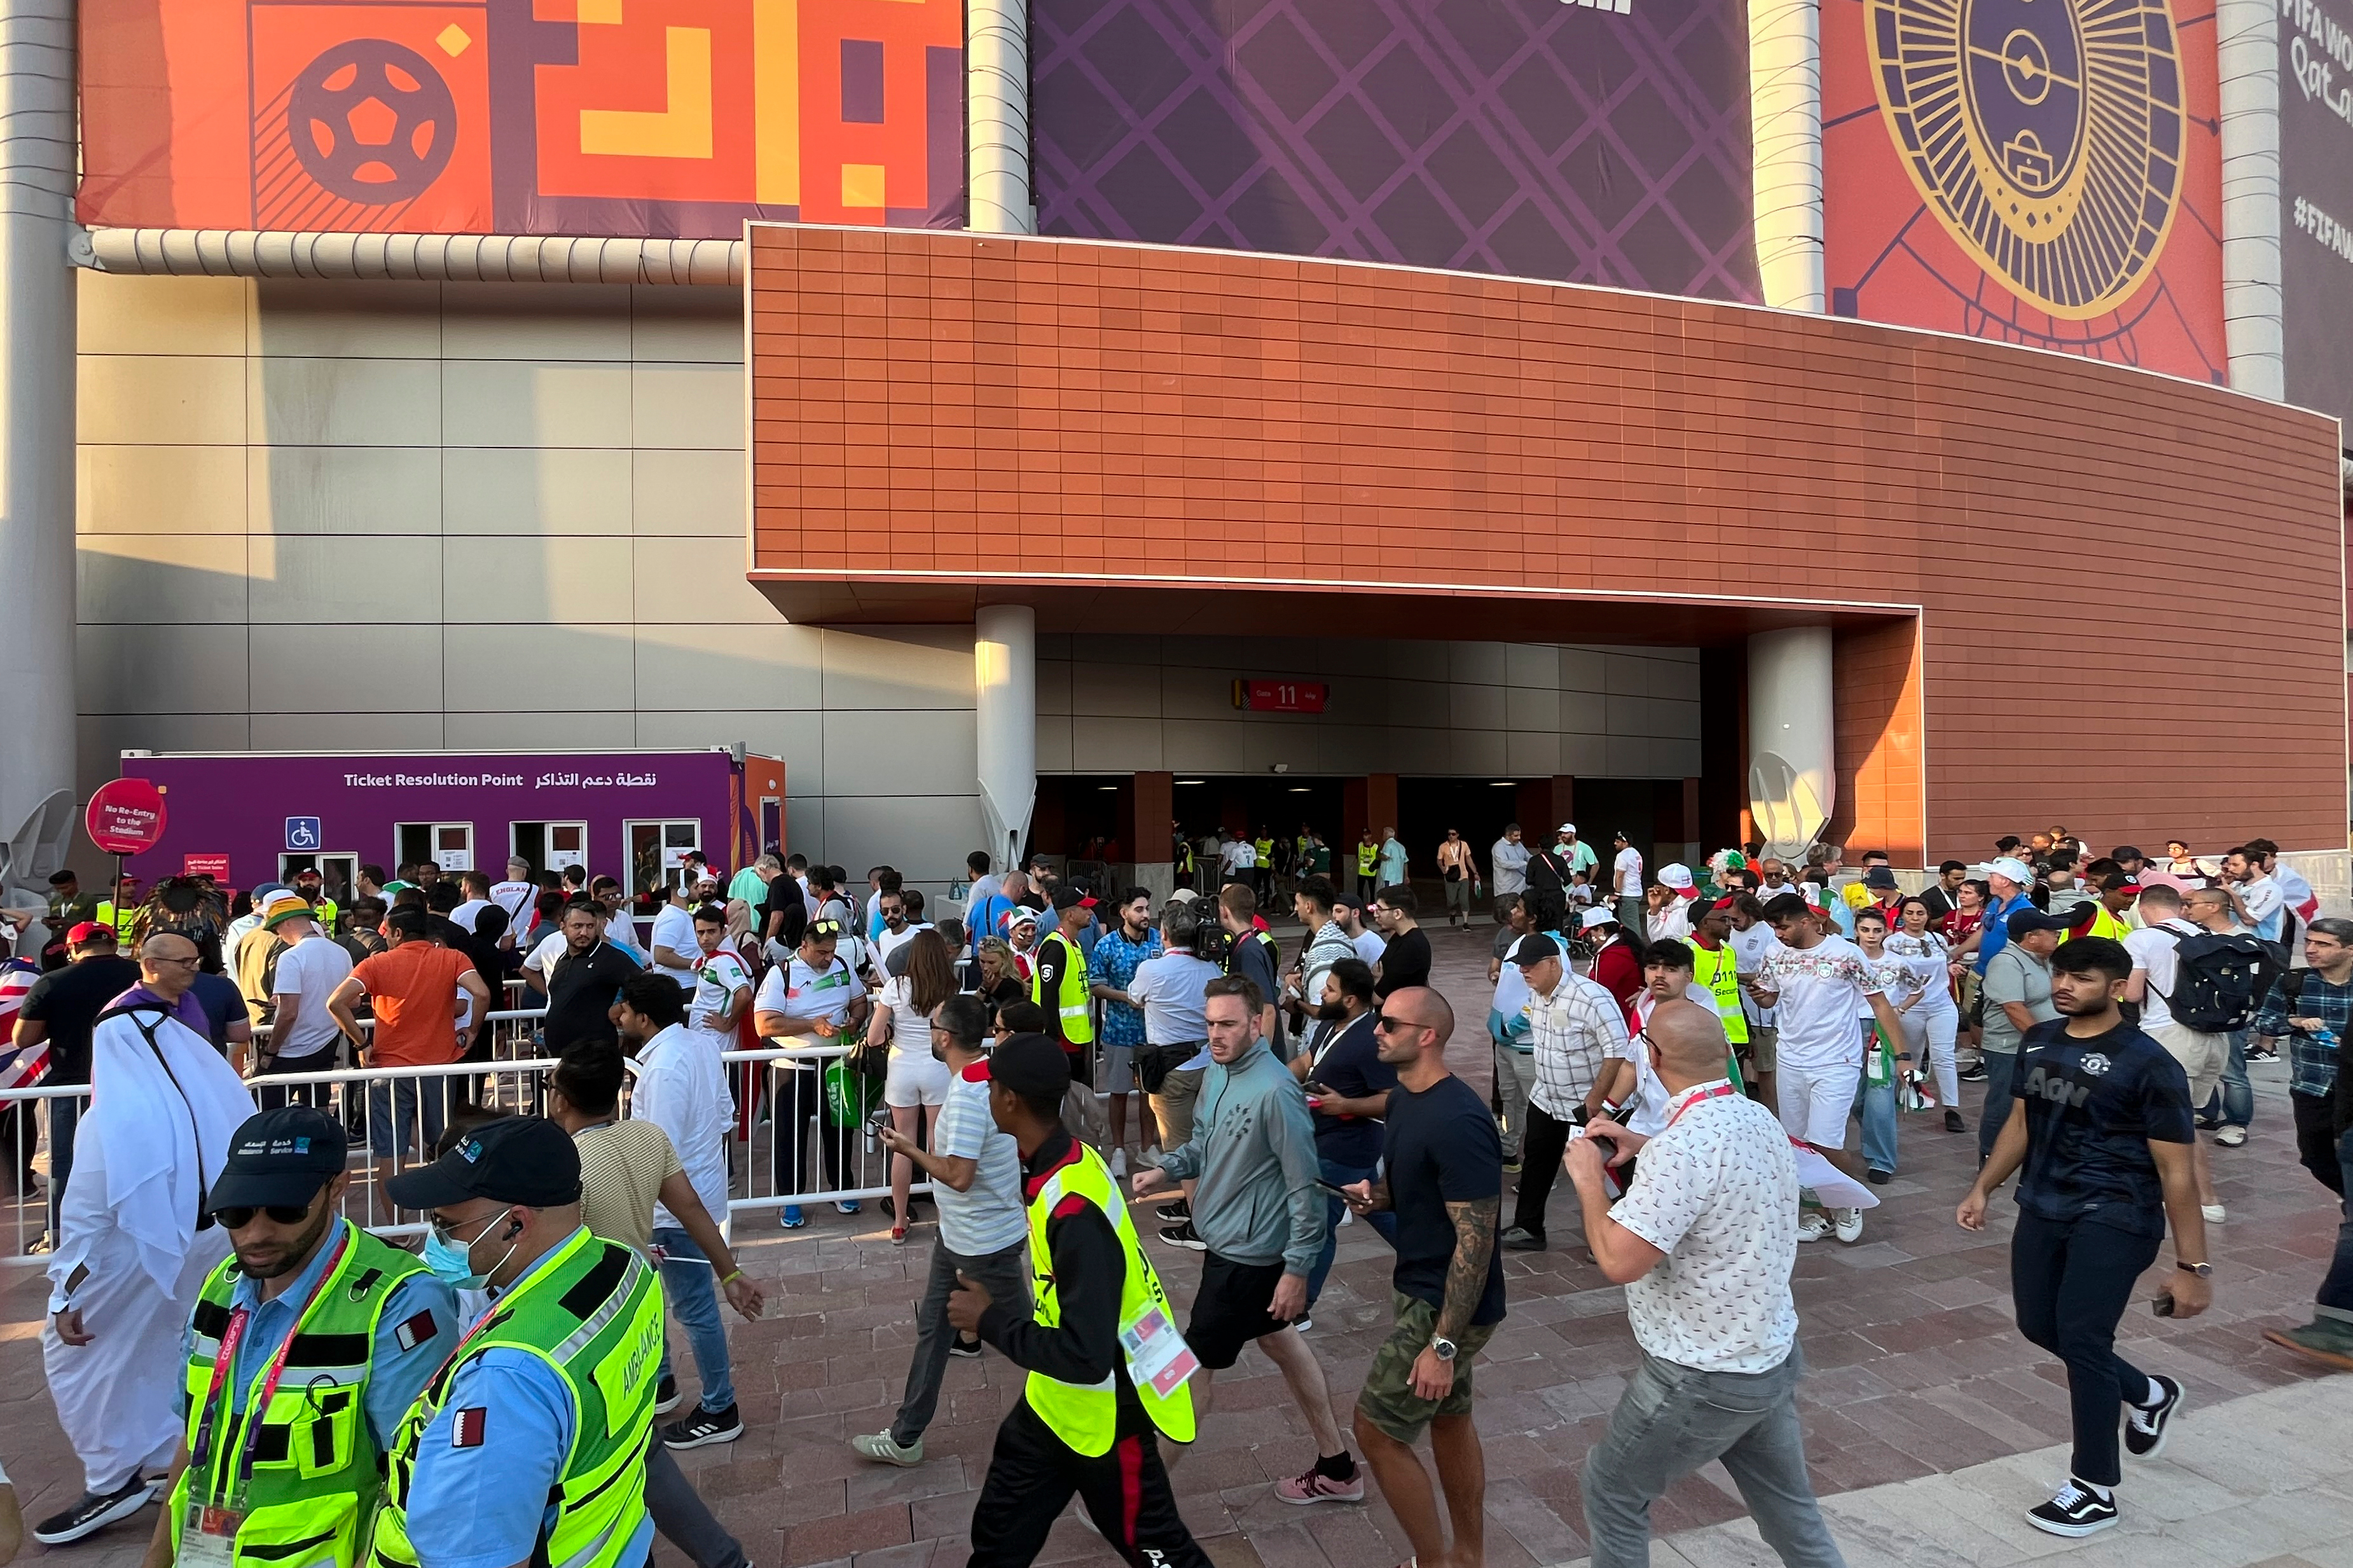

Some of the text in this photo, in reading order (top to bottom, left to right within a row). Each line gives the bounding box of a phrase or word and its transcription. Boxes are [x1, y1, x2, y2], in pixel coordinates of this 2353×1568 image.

[2325, 17, 2353, 76] WO
[2291, 36, 2353, 127] Qata
[1278, 685, 1295, 704] 11
[344, 773, 523, 787] Ticket Resolution Point
[535, 773, 657, 788] نقطة دعم التذاكر
[118, 807, 155, 820] Re-Entry
[127, 818, 141, 826] the
[109, 826, 144, 836] Stadium
[496, 886, 528, 895] ENGLAN
[1713, 970, 1737, 983] 011
